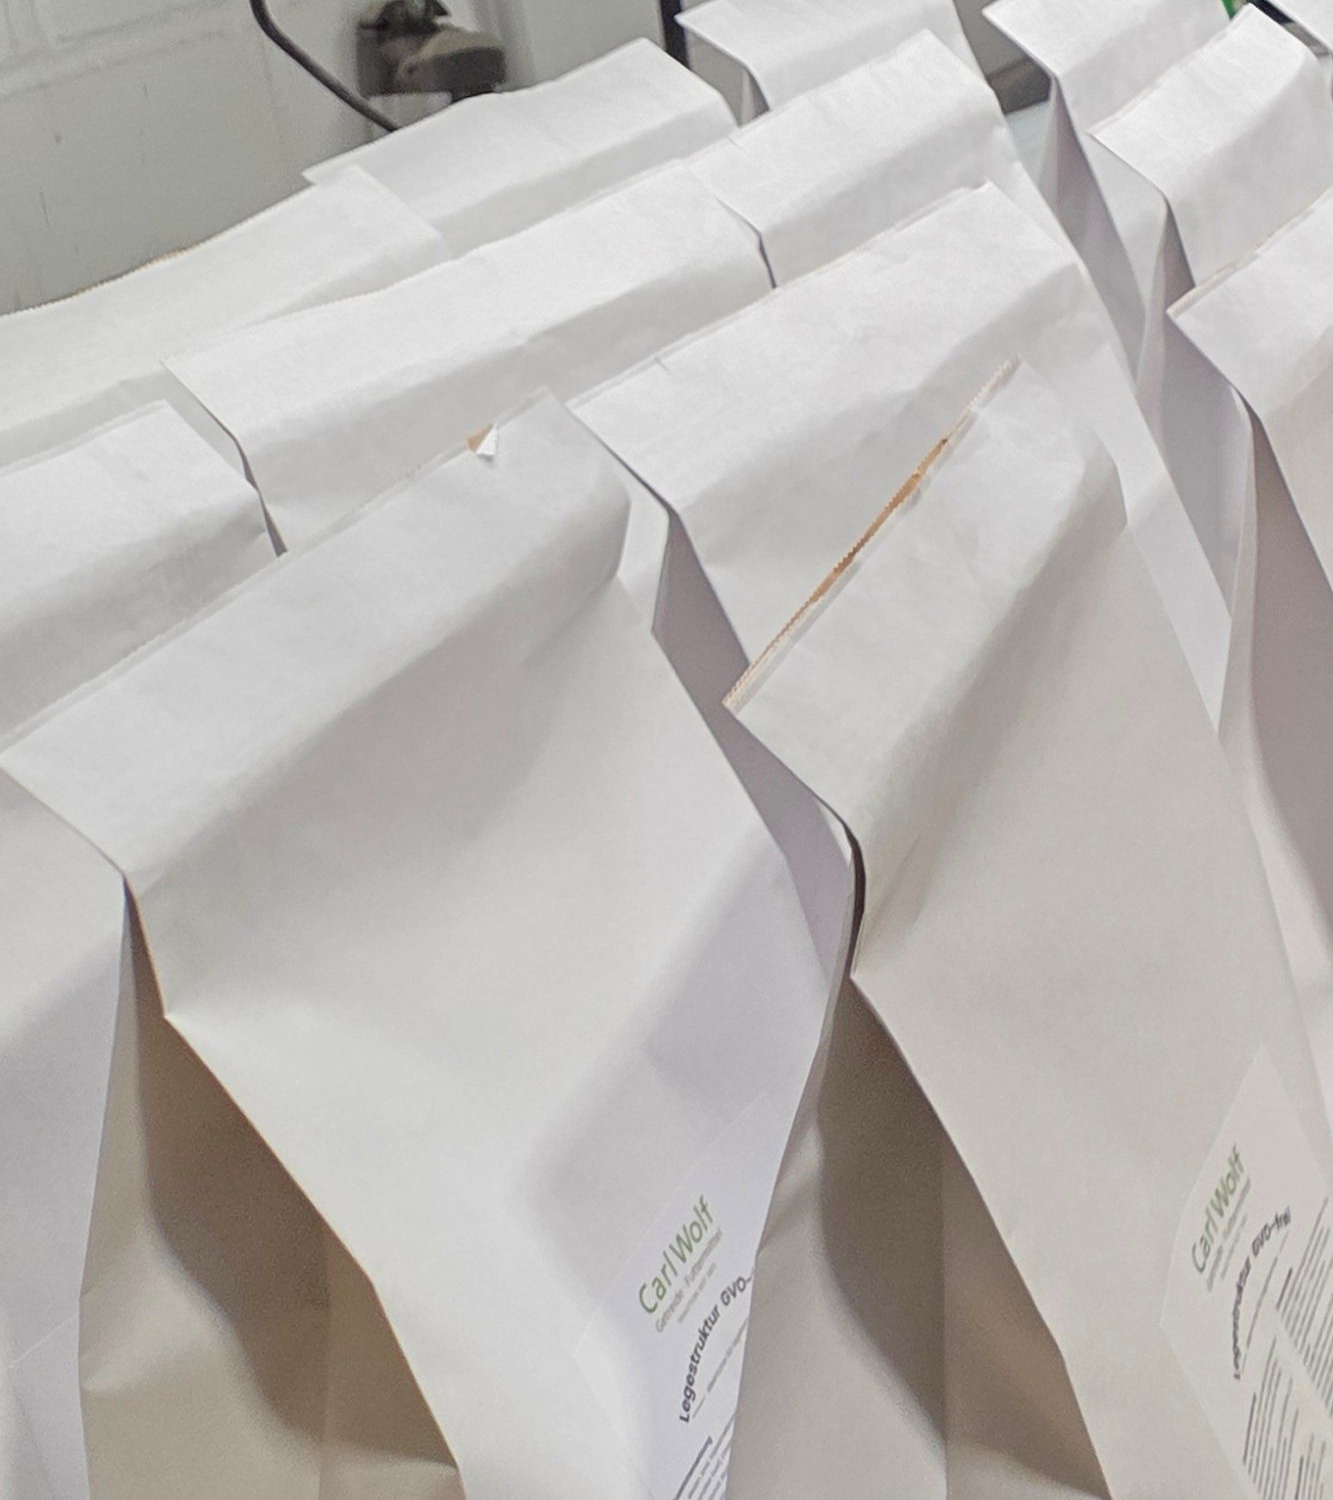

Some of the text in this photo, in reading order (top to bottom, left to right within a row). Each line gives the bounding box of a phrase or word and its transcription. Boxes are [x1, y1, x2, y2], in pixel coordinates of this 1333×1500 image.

[638, 1250, 679, 1315] Carl
[668, 1194, 714, 1265] Wolf
[1192, 1205, 1219, 1273] Carl
[1210, 1143, 1244, 1218] Wolf
